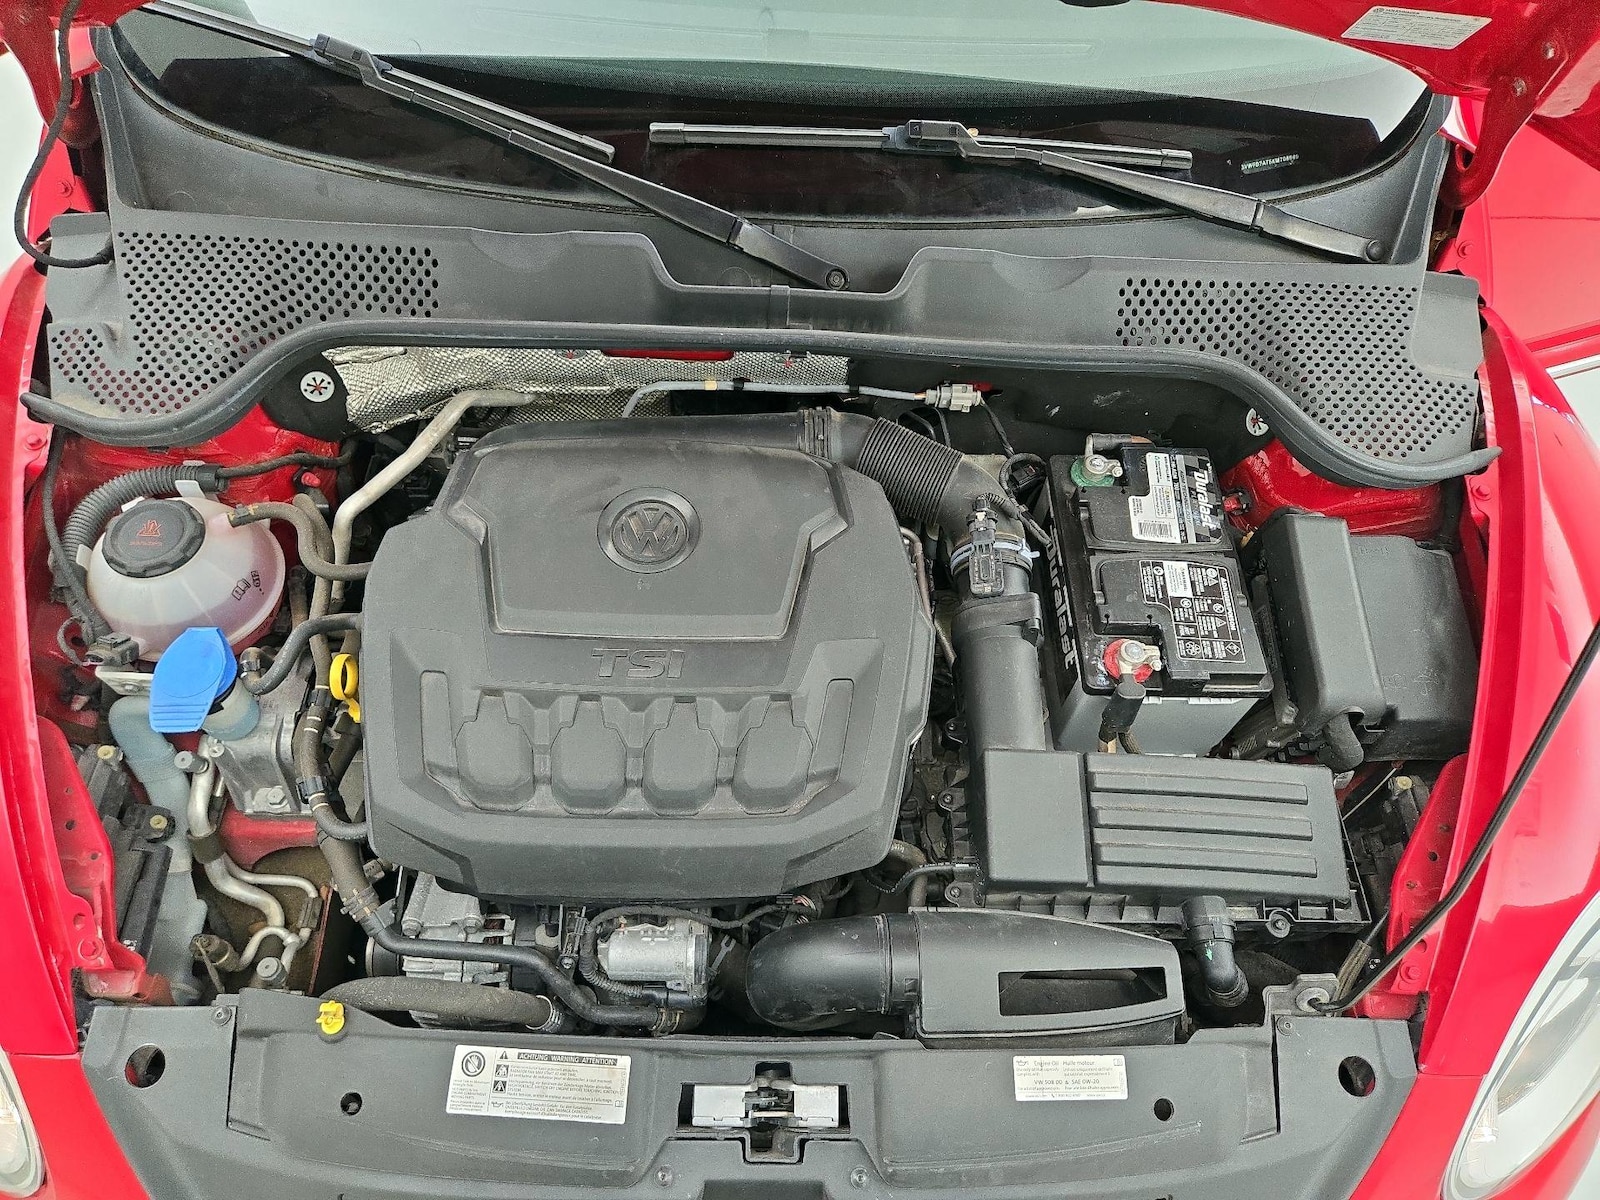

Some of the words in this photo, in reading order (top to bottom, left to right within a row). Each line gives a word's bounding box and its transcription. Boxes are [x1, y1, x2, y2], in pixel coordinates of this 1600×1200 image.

[1194, 470, 1218, 531] Duralast
[591, 648, 685, 679] TSI
[519, 1053, 548, 1061] ACHTUNG
[550, 1055, 579, 1063] WARNING
[582, 1057, 615, 1065] ATTENTION
